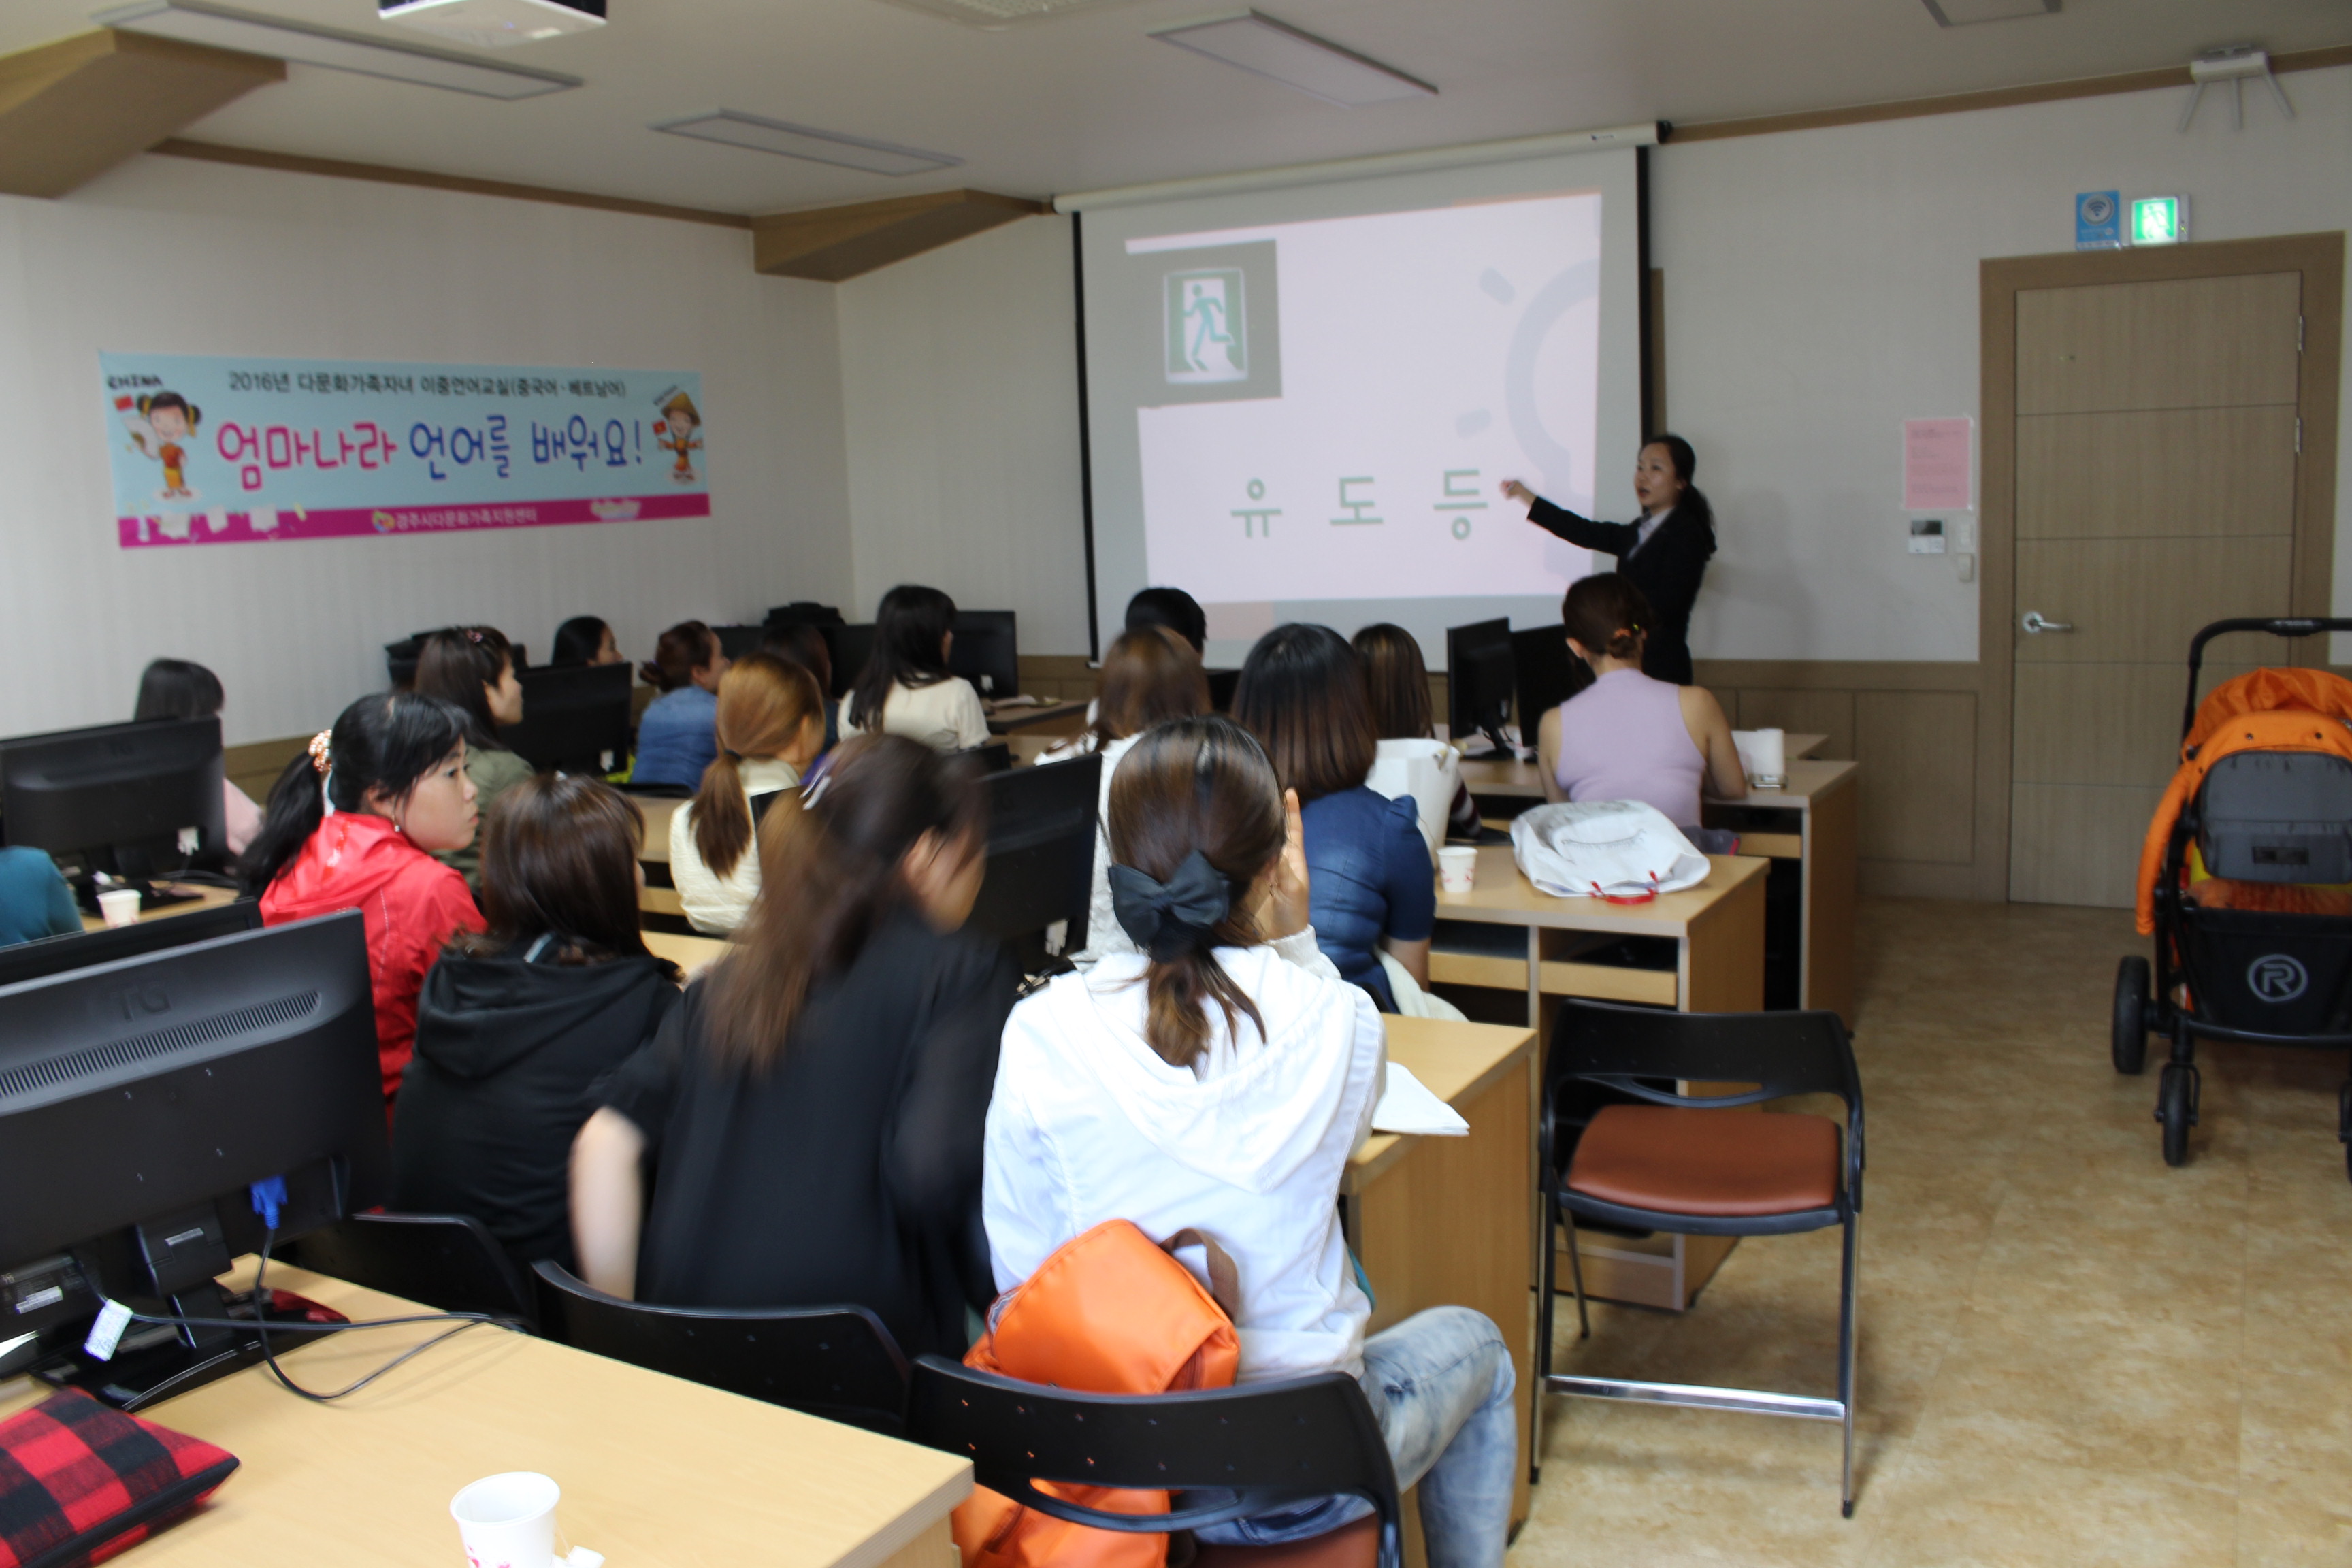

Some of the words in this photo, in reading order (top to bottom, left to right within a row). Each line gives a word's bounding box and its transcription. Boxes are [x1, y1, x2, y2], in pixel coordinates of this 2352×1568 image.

[229, 370, 290, 393] 2016년
[298, 372, 414, 395] 다문화가족자녀
[217, 421, 398, 492] 엄마나라
[410, 414, 510, 480] 언어를
[531, 414, 642, 472] 배워요!
